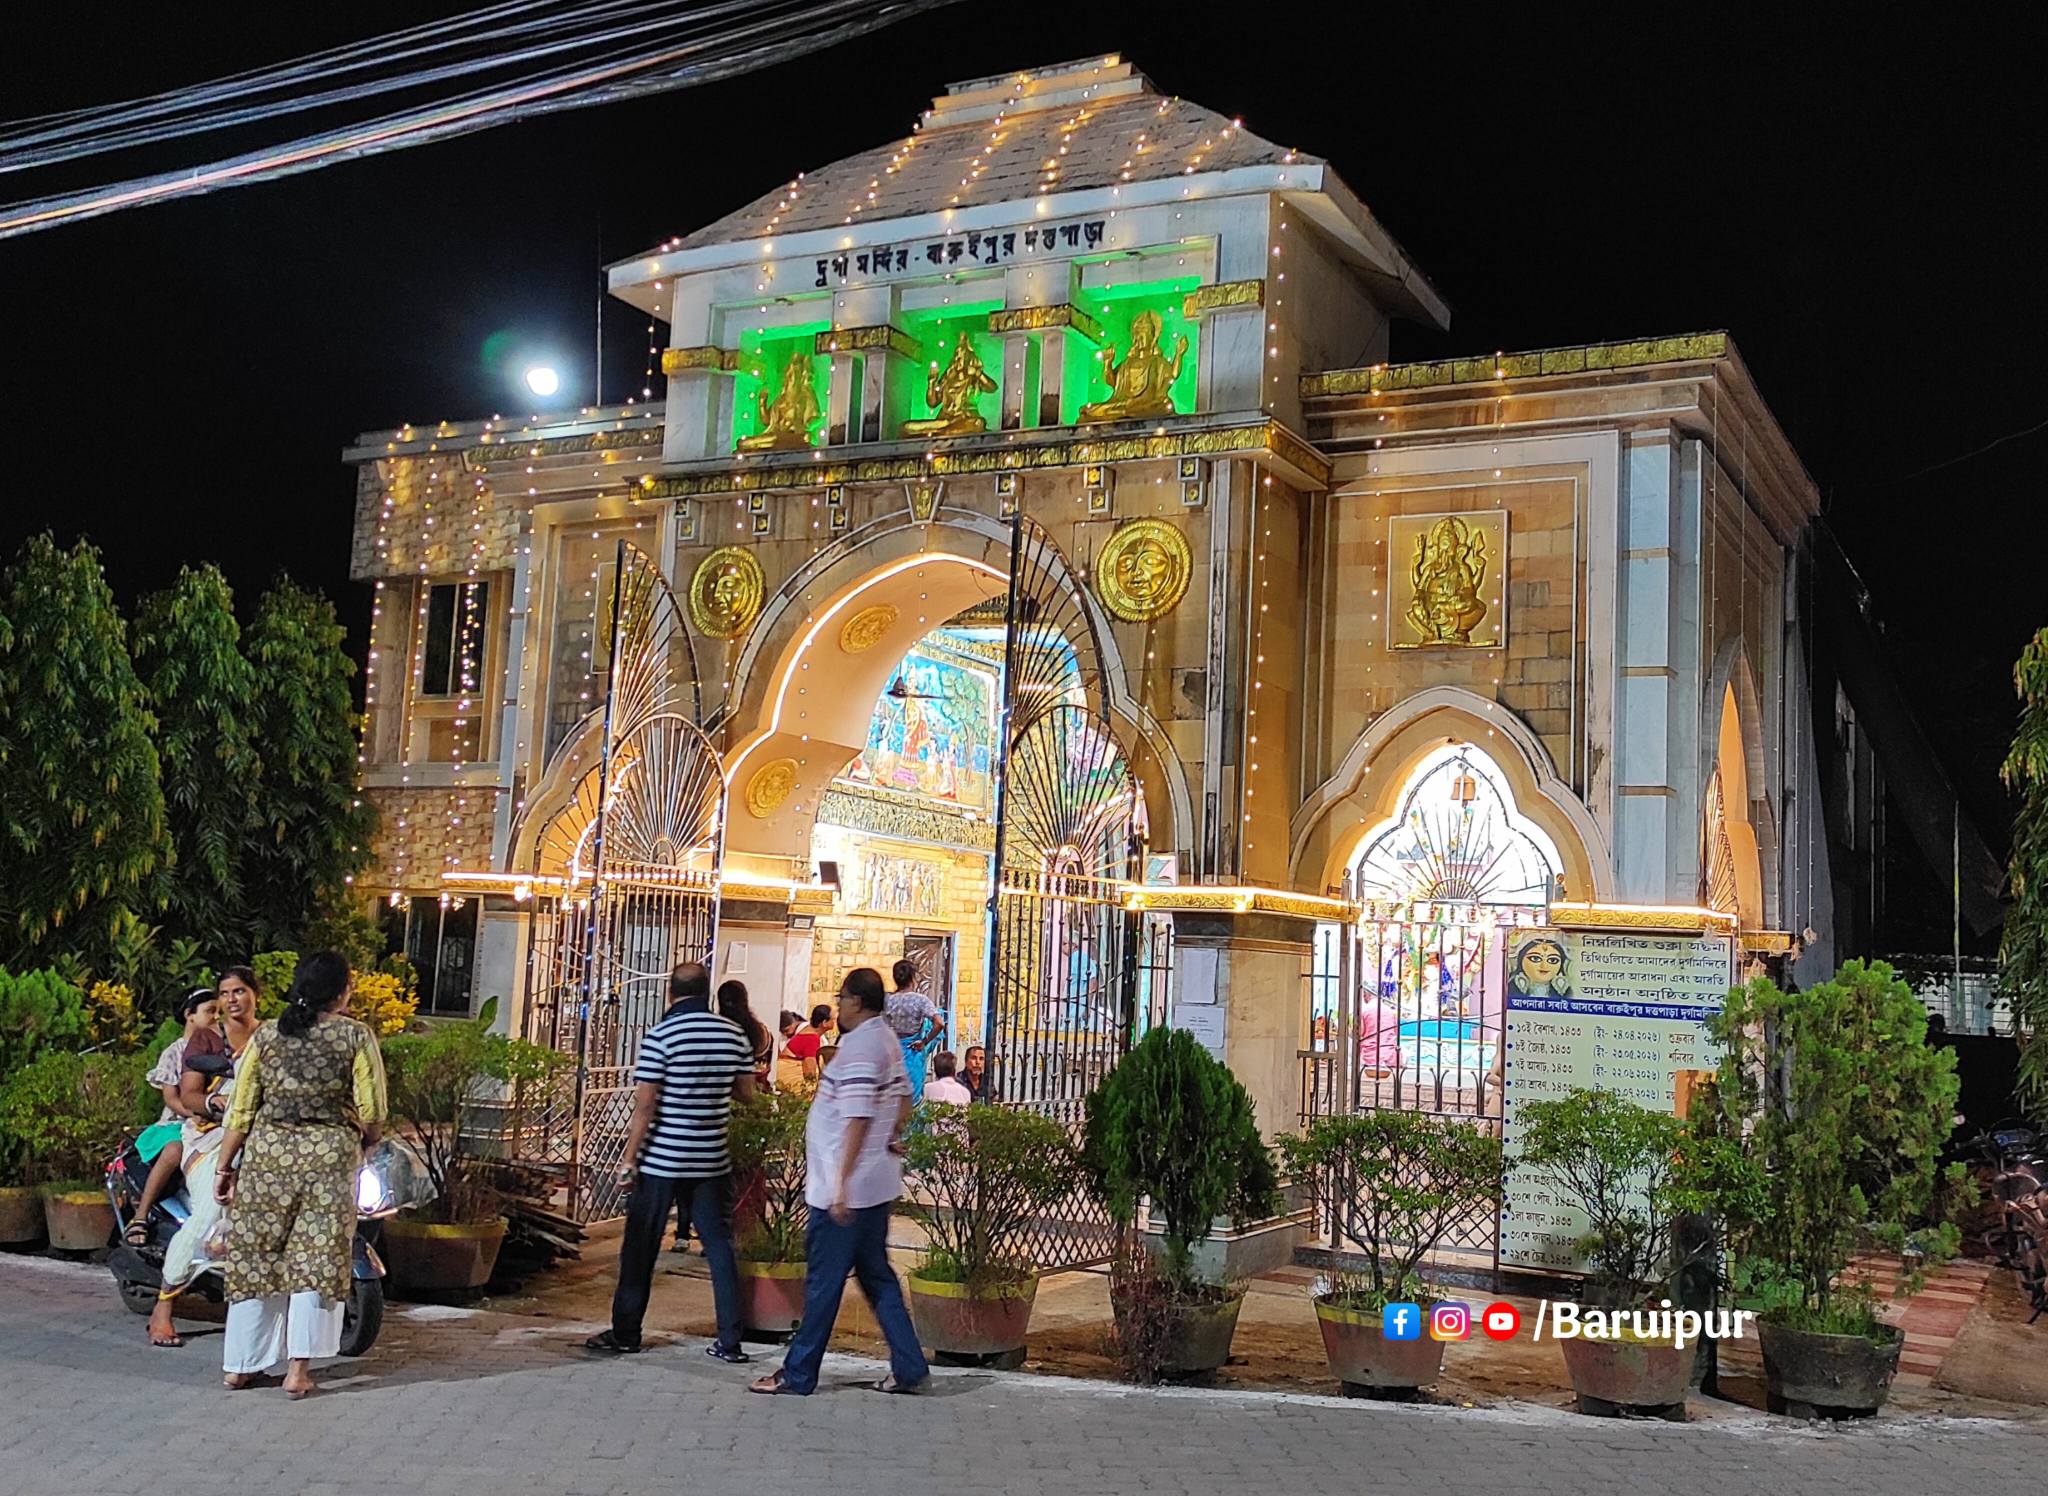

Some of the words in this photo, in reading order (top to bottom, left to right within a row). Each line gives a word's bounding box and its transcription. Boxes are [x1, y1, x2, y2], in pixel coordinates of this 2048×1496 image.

[816, 254, 849, 287] দুর্গা
[857, 246, 908, 274] মন্দির
[926, 231, 1016, 264] বারুইপুর
[1025, 220, 1105, 249] দত্তপাড়া
[1581, 952, 1633, 965] তিথিগুলিতে
[1634, 957, 1676, 967] আমাদের
[1628, 973, 1667, 983] আরাধনা
[1670, 975, 1691, 984] এবং
[1693, 973, 1725, 986] আরতি
[1580, 985, 1630, 999] অনুষ্ঠান
[1635, 988, 1690, 1001] অনুষ্ঠিত
[1511, 998, 1546, 1009] আপনারা
[1548, 1000, 1569, 1011] সবাই
[1606, 1003, 1643, 1017] বারুইপুর
[1560, 1026, 1582, 1036] ১৪৩৩
[1550, 1044, 1572, 1054] ১৪৩৩
[1668, 1048, 1695, 1064] শনিবার
[1552, 1063, 1574, 1074] ১৪৩৩
[1550, 1215, 1572, 1226] ১৪৩৩
[1550, 1254, 1573, 1266] ১৪৩৩
